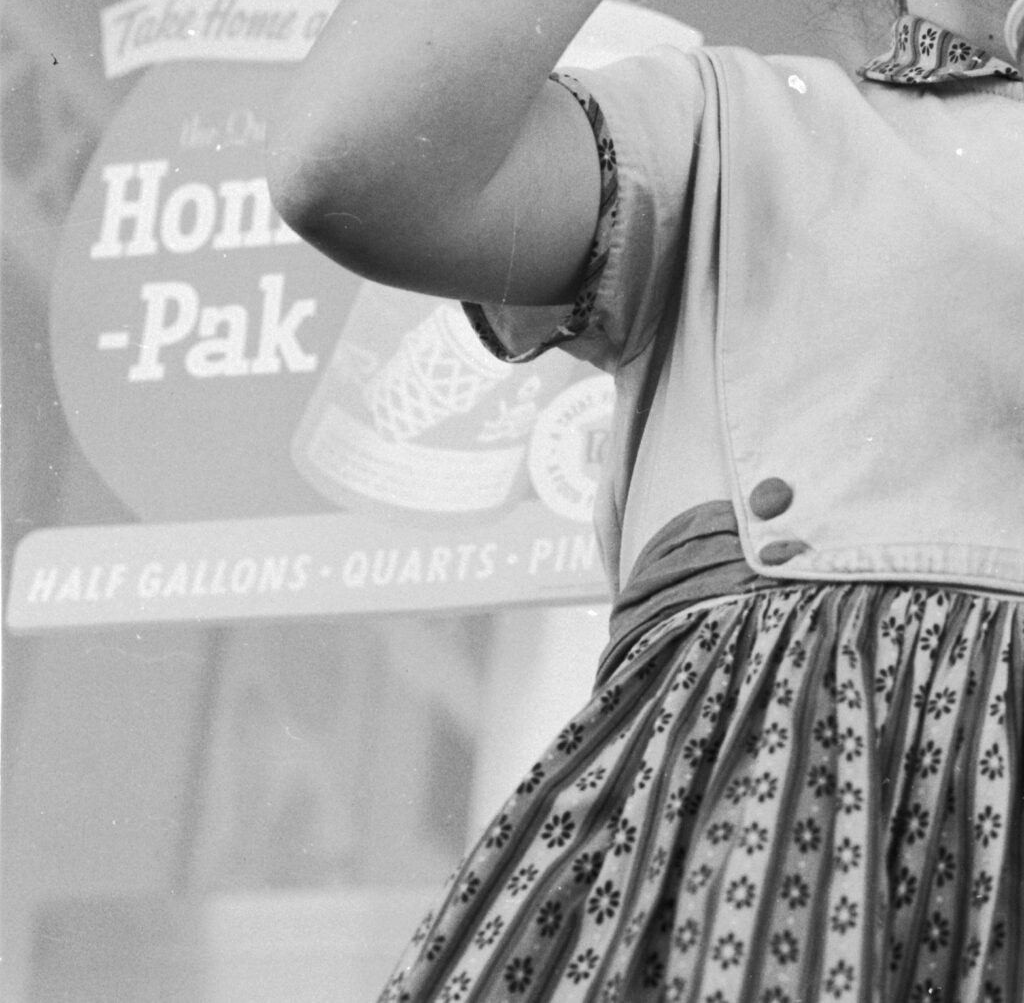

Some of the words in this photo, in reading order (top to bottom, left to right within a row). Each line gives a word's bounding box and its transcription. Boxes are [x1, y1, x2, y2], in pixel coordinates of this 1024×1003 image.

[27, 564, 126, 602] HALF
[137, 554, 310, 598] GALLONS
[342, 541, 498, 590] QUARTS
[528, 532, 596, 575] PIN
